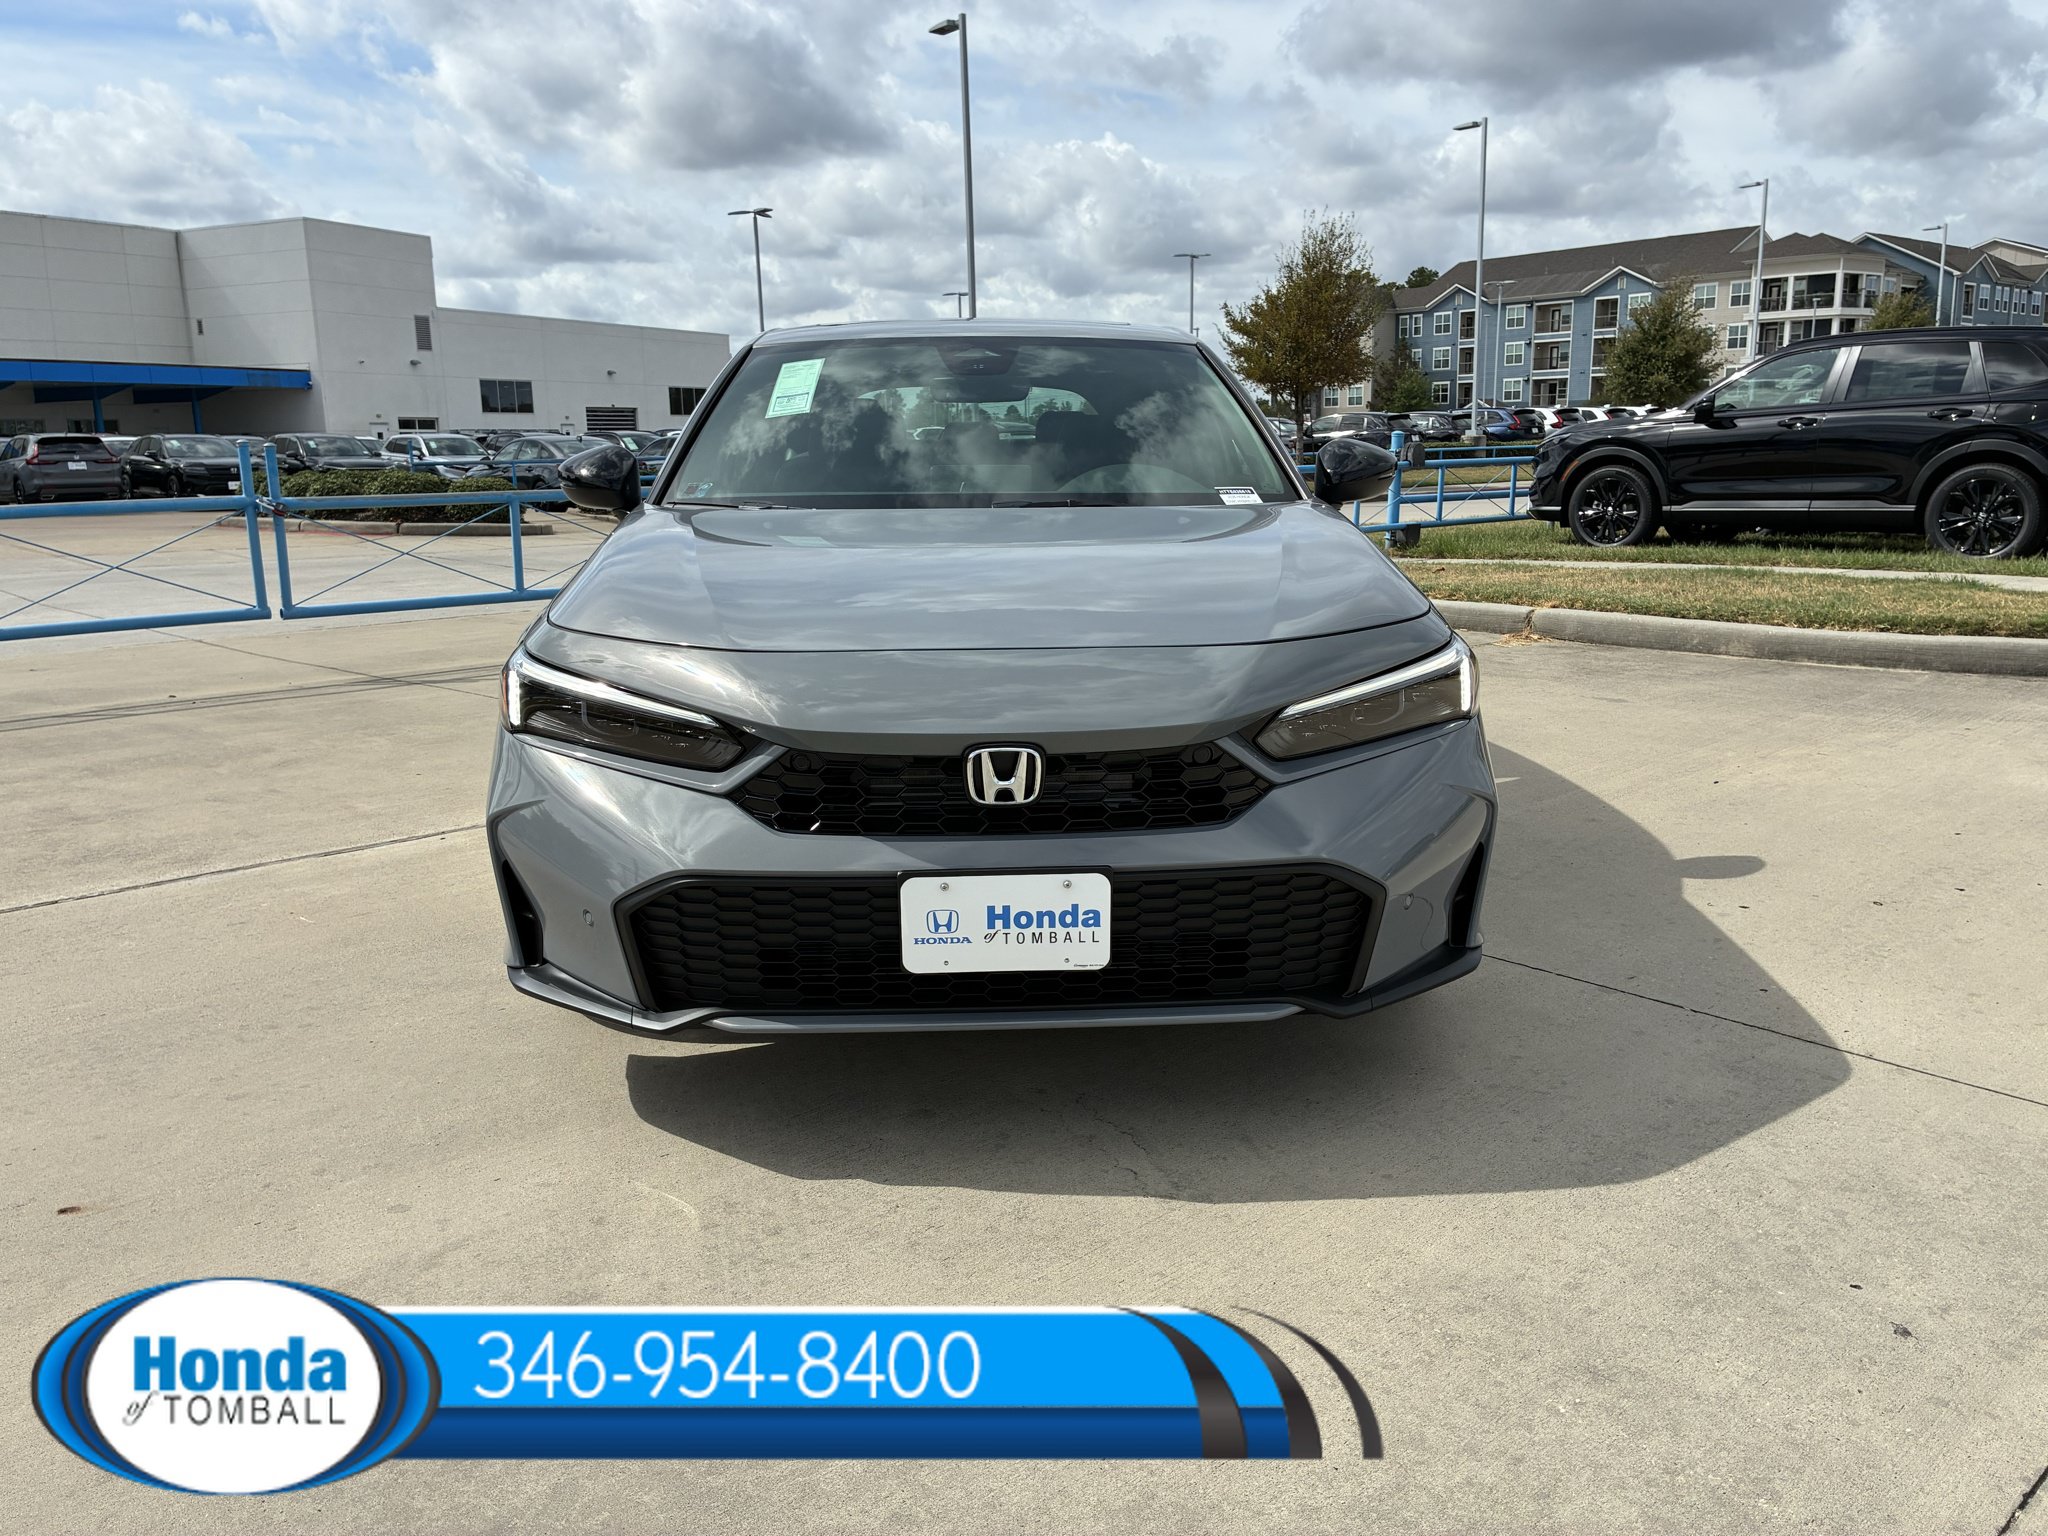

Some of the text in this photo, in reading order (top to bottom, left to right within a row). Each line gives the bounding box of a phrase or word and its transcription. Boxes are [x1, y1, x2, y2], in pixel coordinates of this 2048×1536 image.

[986, 903, 1102, 930] Honda
[913, 936, 973, 945] HONDA
[983, 929, 1100, 945] of TOMBALL
